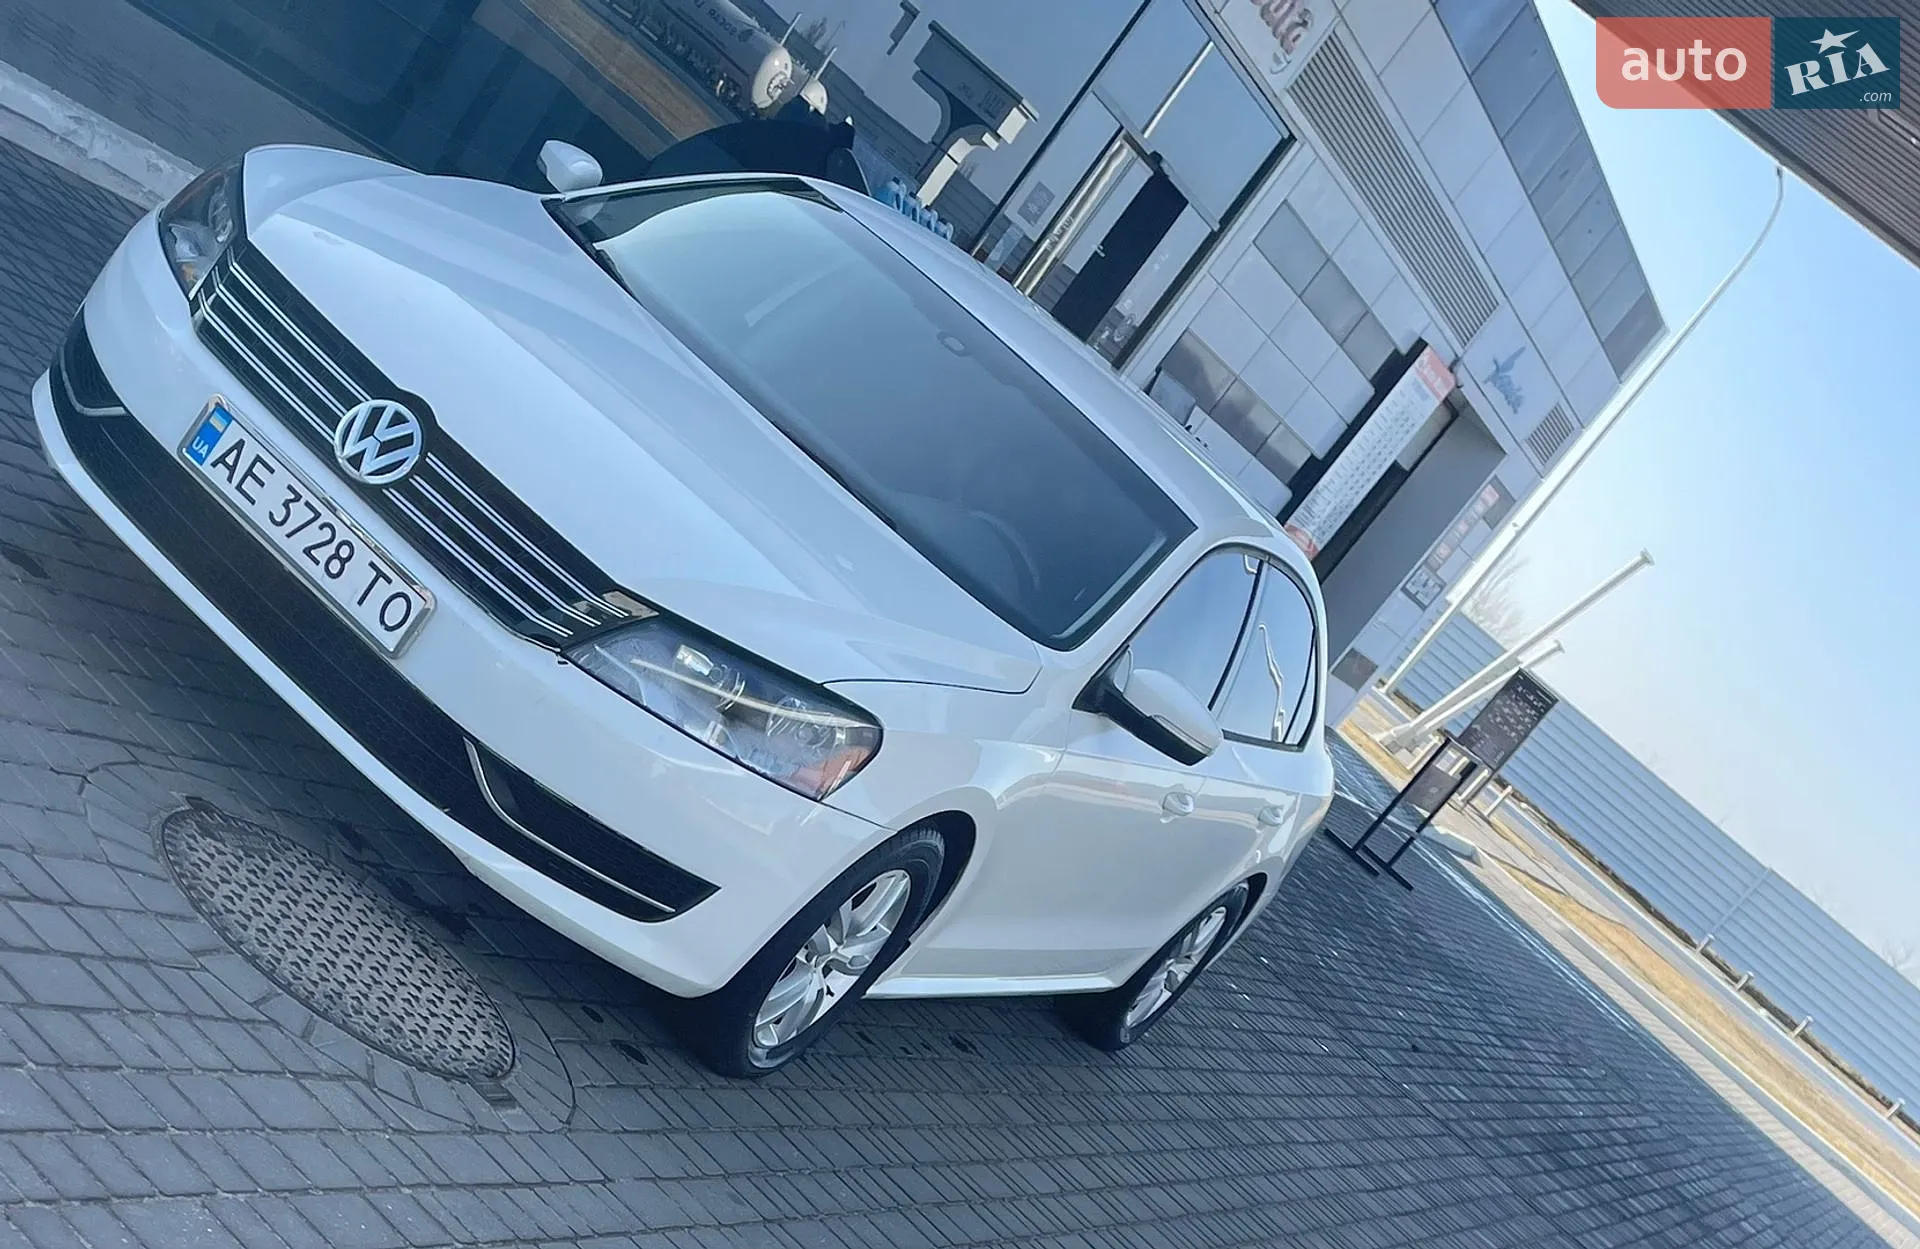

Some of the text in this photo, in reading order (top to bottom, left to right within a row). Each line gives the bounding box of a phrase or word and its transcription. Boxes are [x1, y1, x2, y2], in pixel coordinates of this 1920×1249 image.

[192, 436, 210, 459] UA
[210, 438, 412, 633] AE 3728 TO
